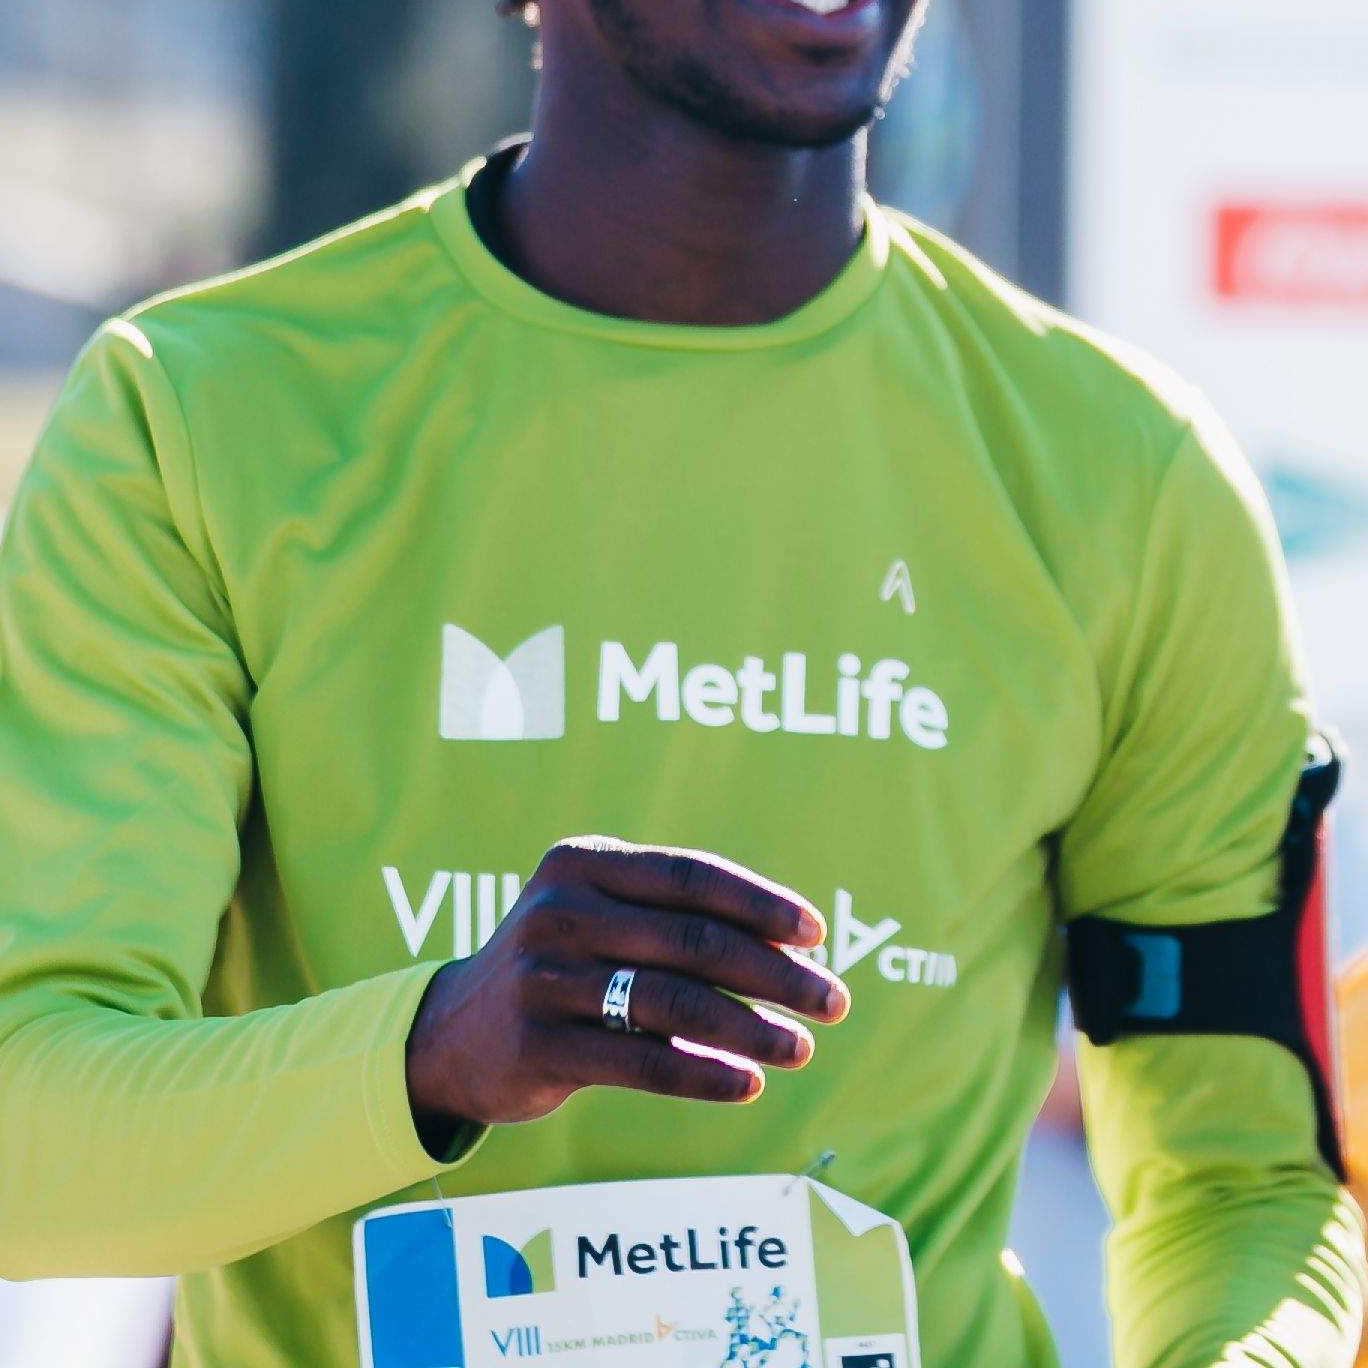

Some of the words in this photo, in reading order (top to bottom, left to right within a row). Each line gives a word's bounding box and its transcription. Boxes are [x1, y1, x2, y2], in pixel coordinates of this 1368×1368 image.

[597, 641, 949, 750] MetLife
[577, 1226, 787, 1278] MetLife
[489, 1325, 542, 1359] VIII
[592, 1331, 655, 1348] MADRID
